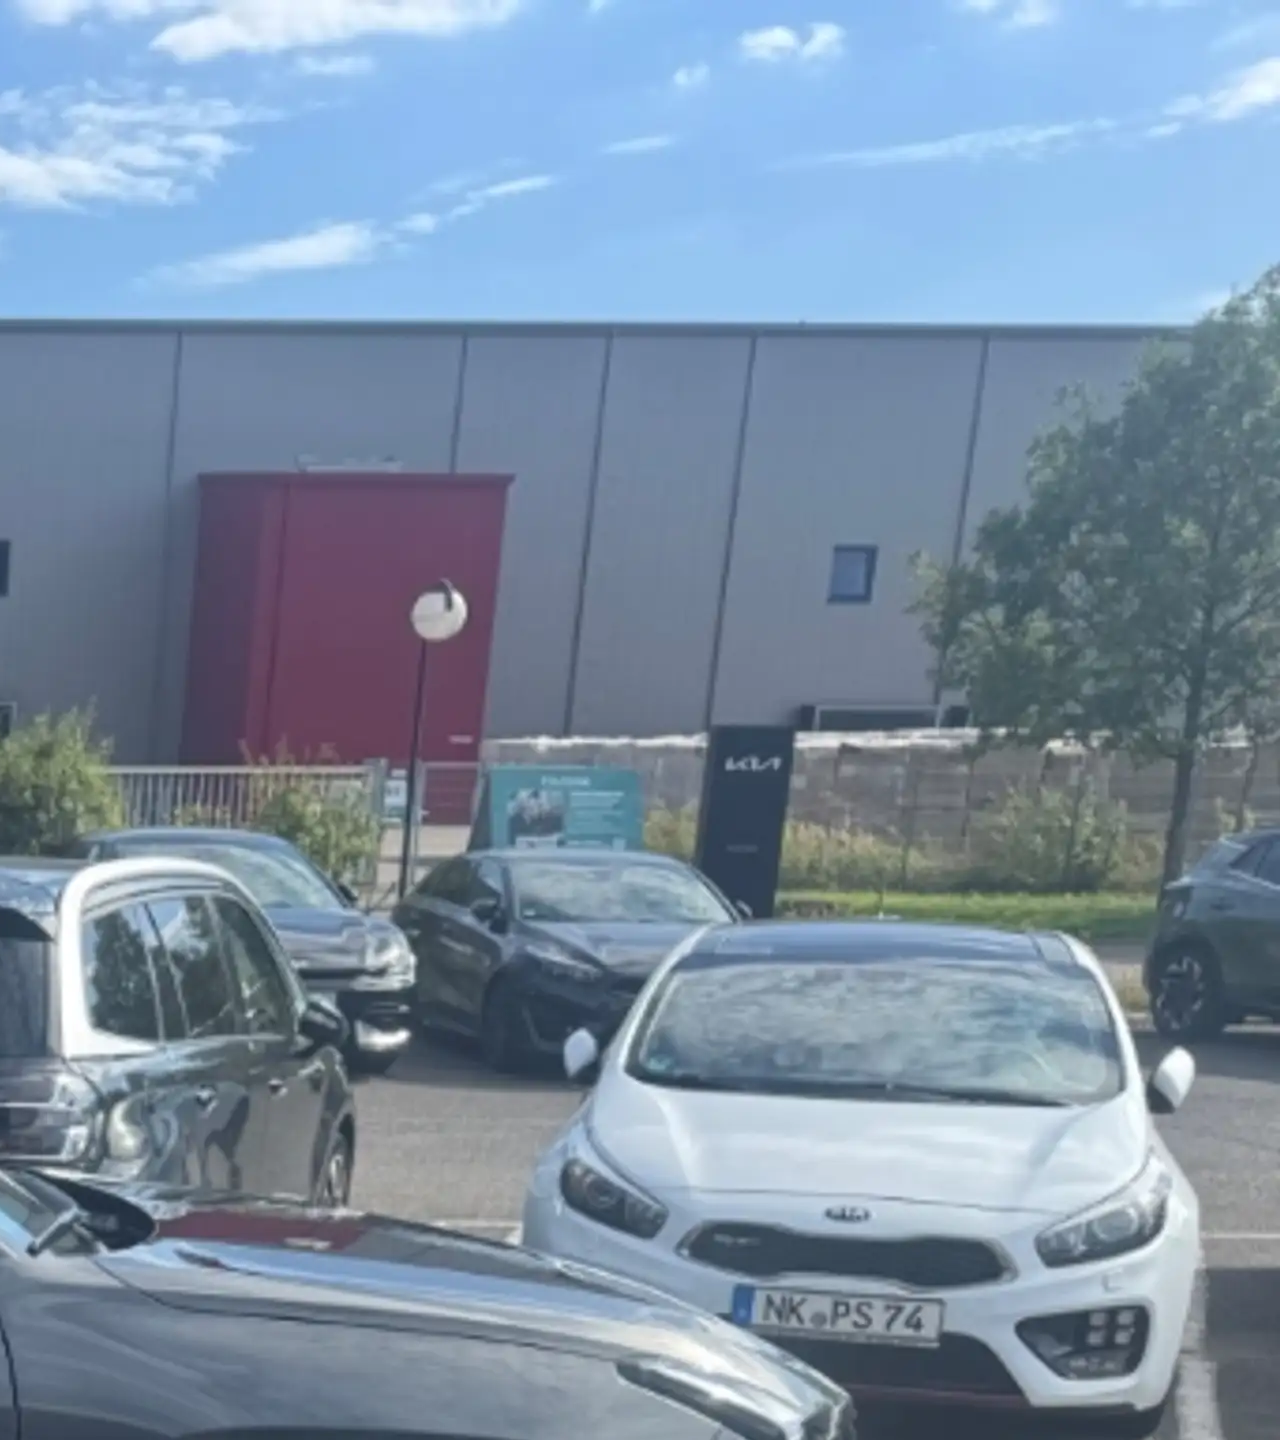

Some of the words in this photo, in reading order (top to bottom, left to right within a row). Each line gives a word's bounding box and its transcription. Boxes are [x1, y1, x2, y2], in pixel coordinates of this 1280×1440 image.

[763, 1294, 808, 1325] NK
[831, 1300, 873, 1330] PS
[885, 1304, 925, 1333] 74
